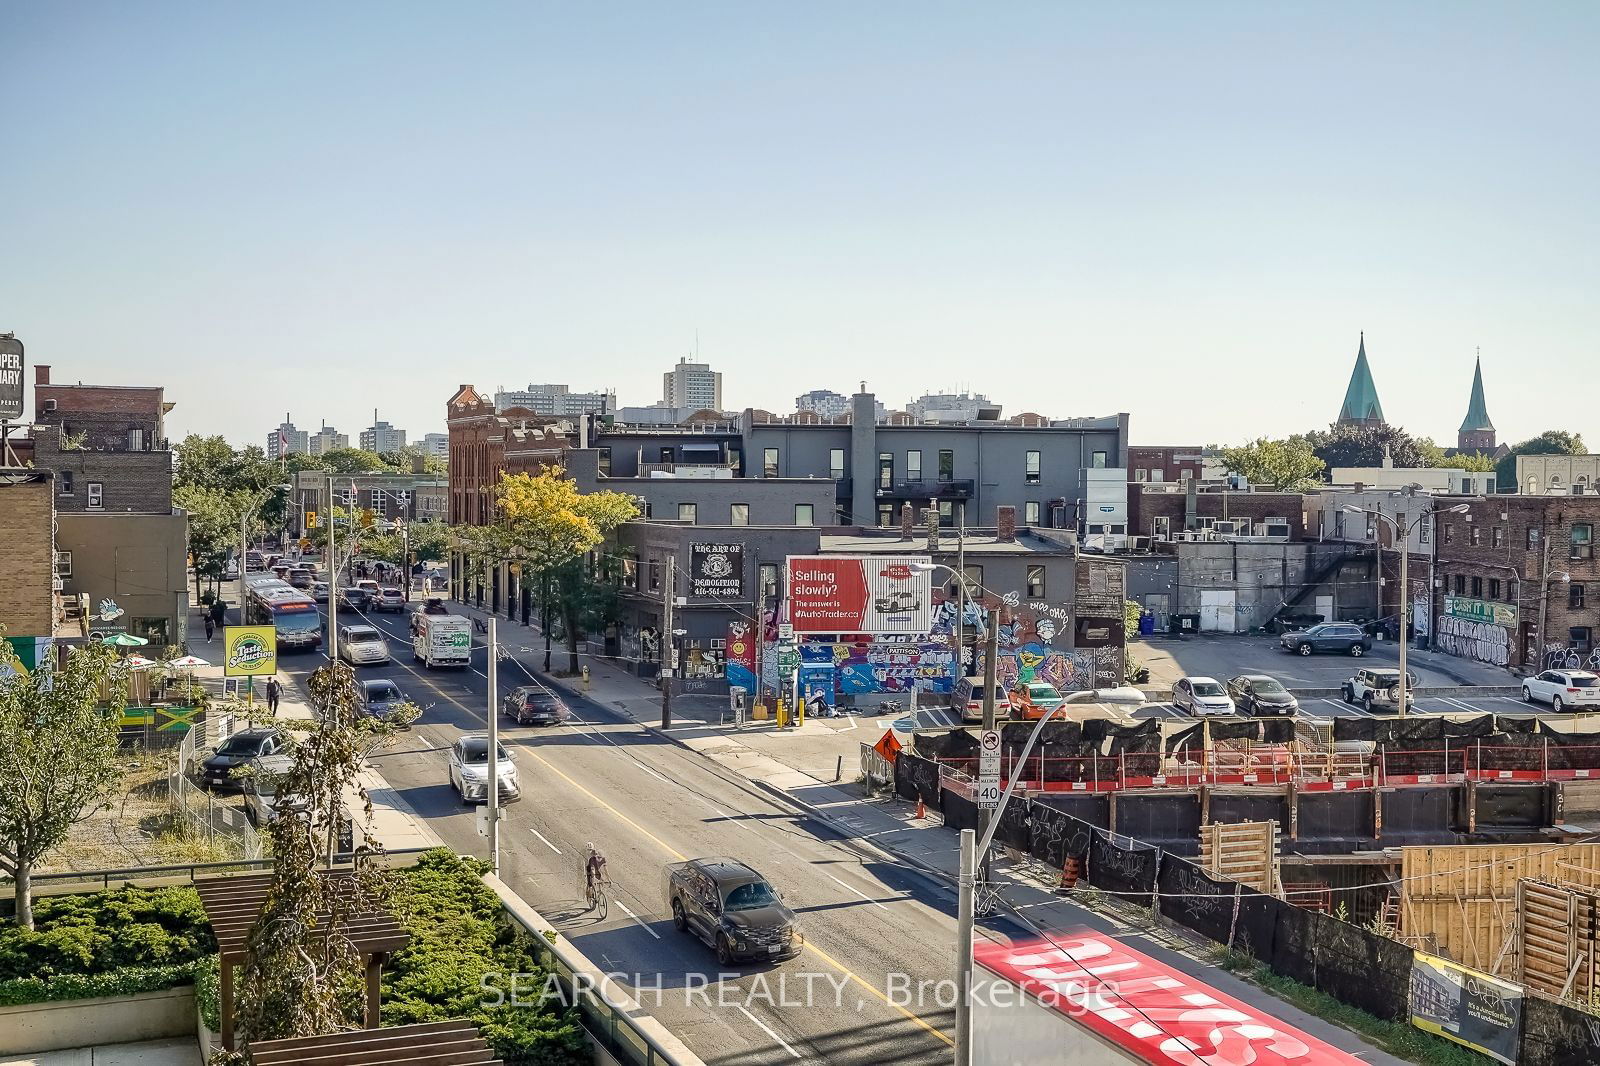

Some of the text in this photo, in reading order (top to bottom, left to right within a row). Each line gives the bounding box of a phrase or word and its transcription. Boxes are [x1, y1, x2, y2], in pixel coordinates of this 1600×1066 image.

[0, 354, 22, 370] PER,
[712, 545, 728, 553] ART
[694, 579, 740, 587] DEMOLITION
[795, 570, 834, 583] Selling
[795, 584, 837, 597] slowly?
[1453, 600, 1472, 612] CASH
[1473, 603, 1482, 614] IT
[801, 610, 858, 618] AutoTrader.ca
[237, 645, 261, 656] Taste
[229, 651, 274, 668] Seduction
[981, 787, 998, 799] 40
[1467, 1001, 1476, 1009] It's
[1480, 1006, 1500, 1019] Junction
[1467, 1010, 1510, 1029] you'll understand.
